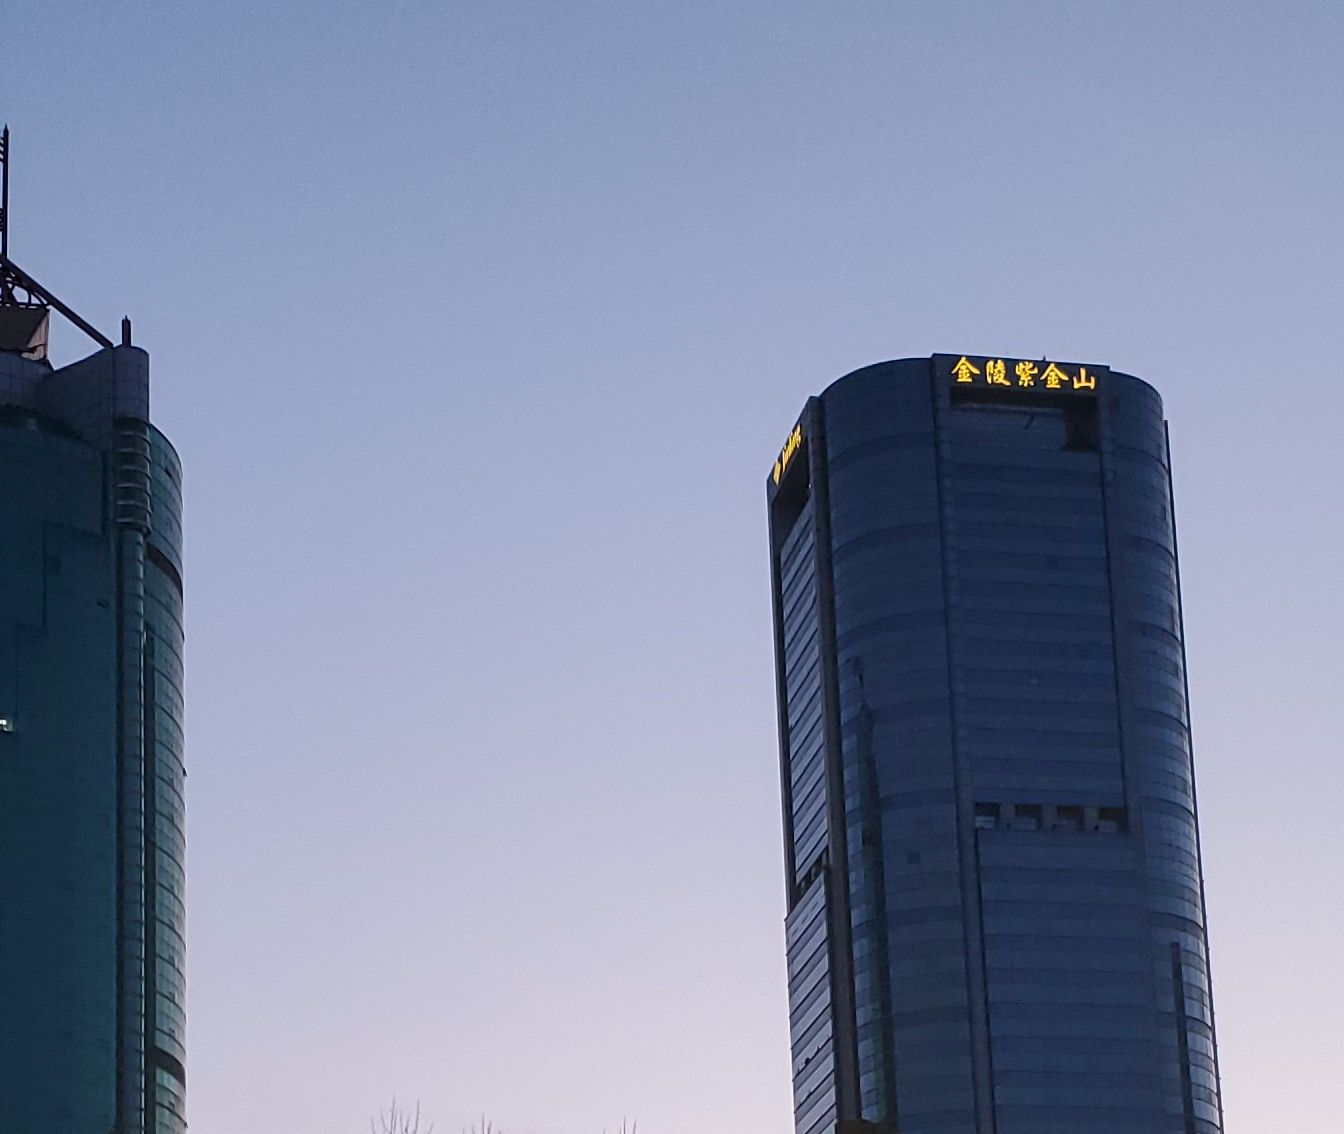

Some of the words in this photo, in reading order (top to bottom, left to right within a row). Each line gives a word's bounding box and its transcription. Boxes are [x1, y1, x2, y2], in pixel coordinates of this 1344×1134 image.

[951, 356, 1096, 390] 金陵紫金山
